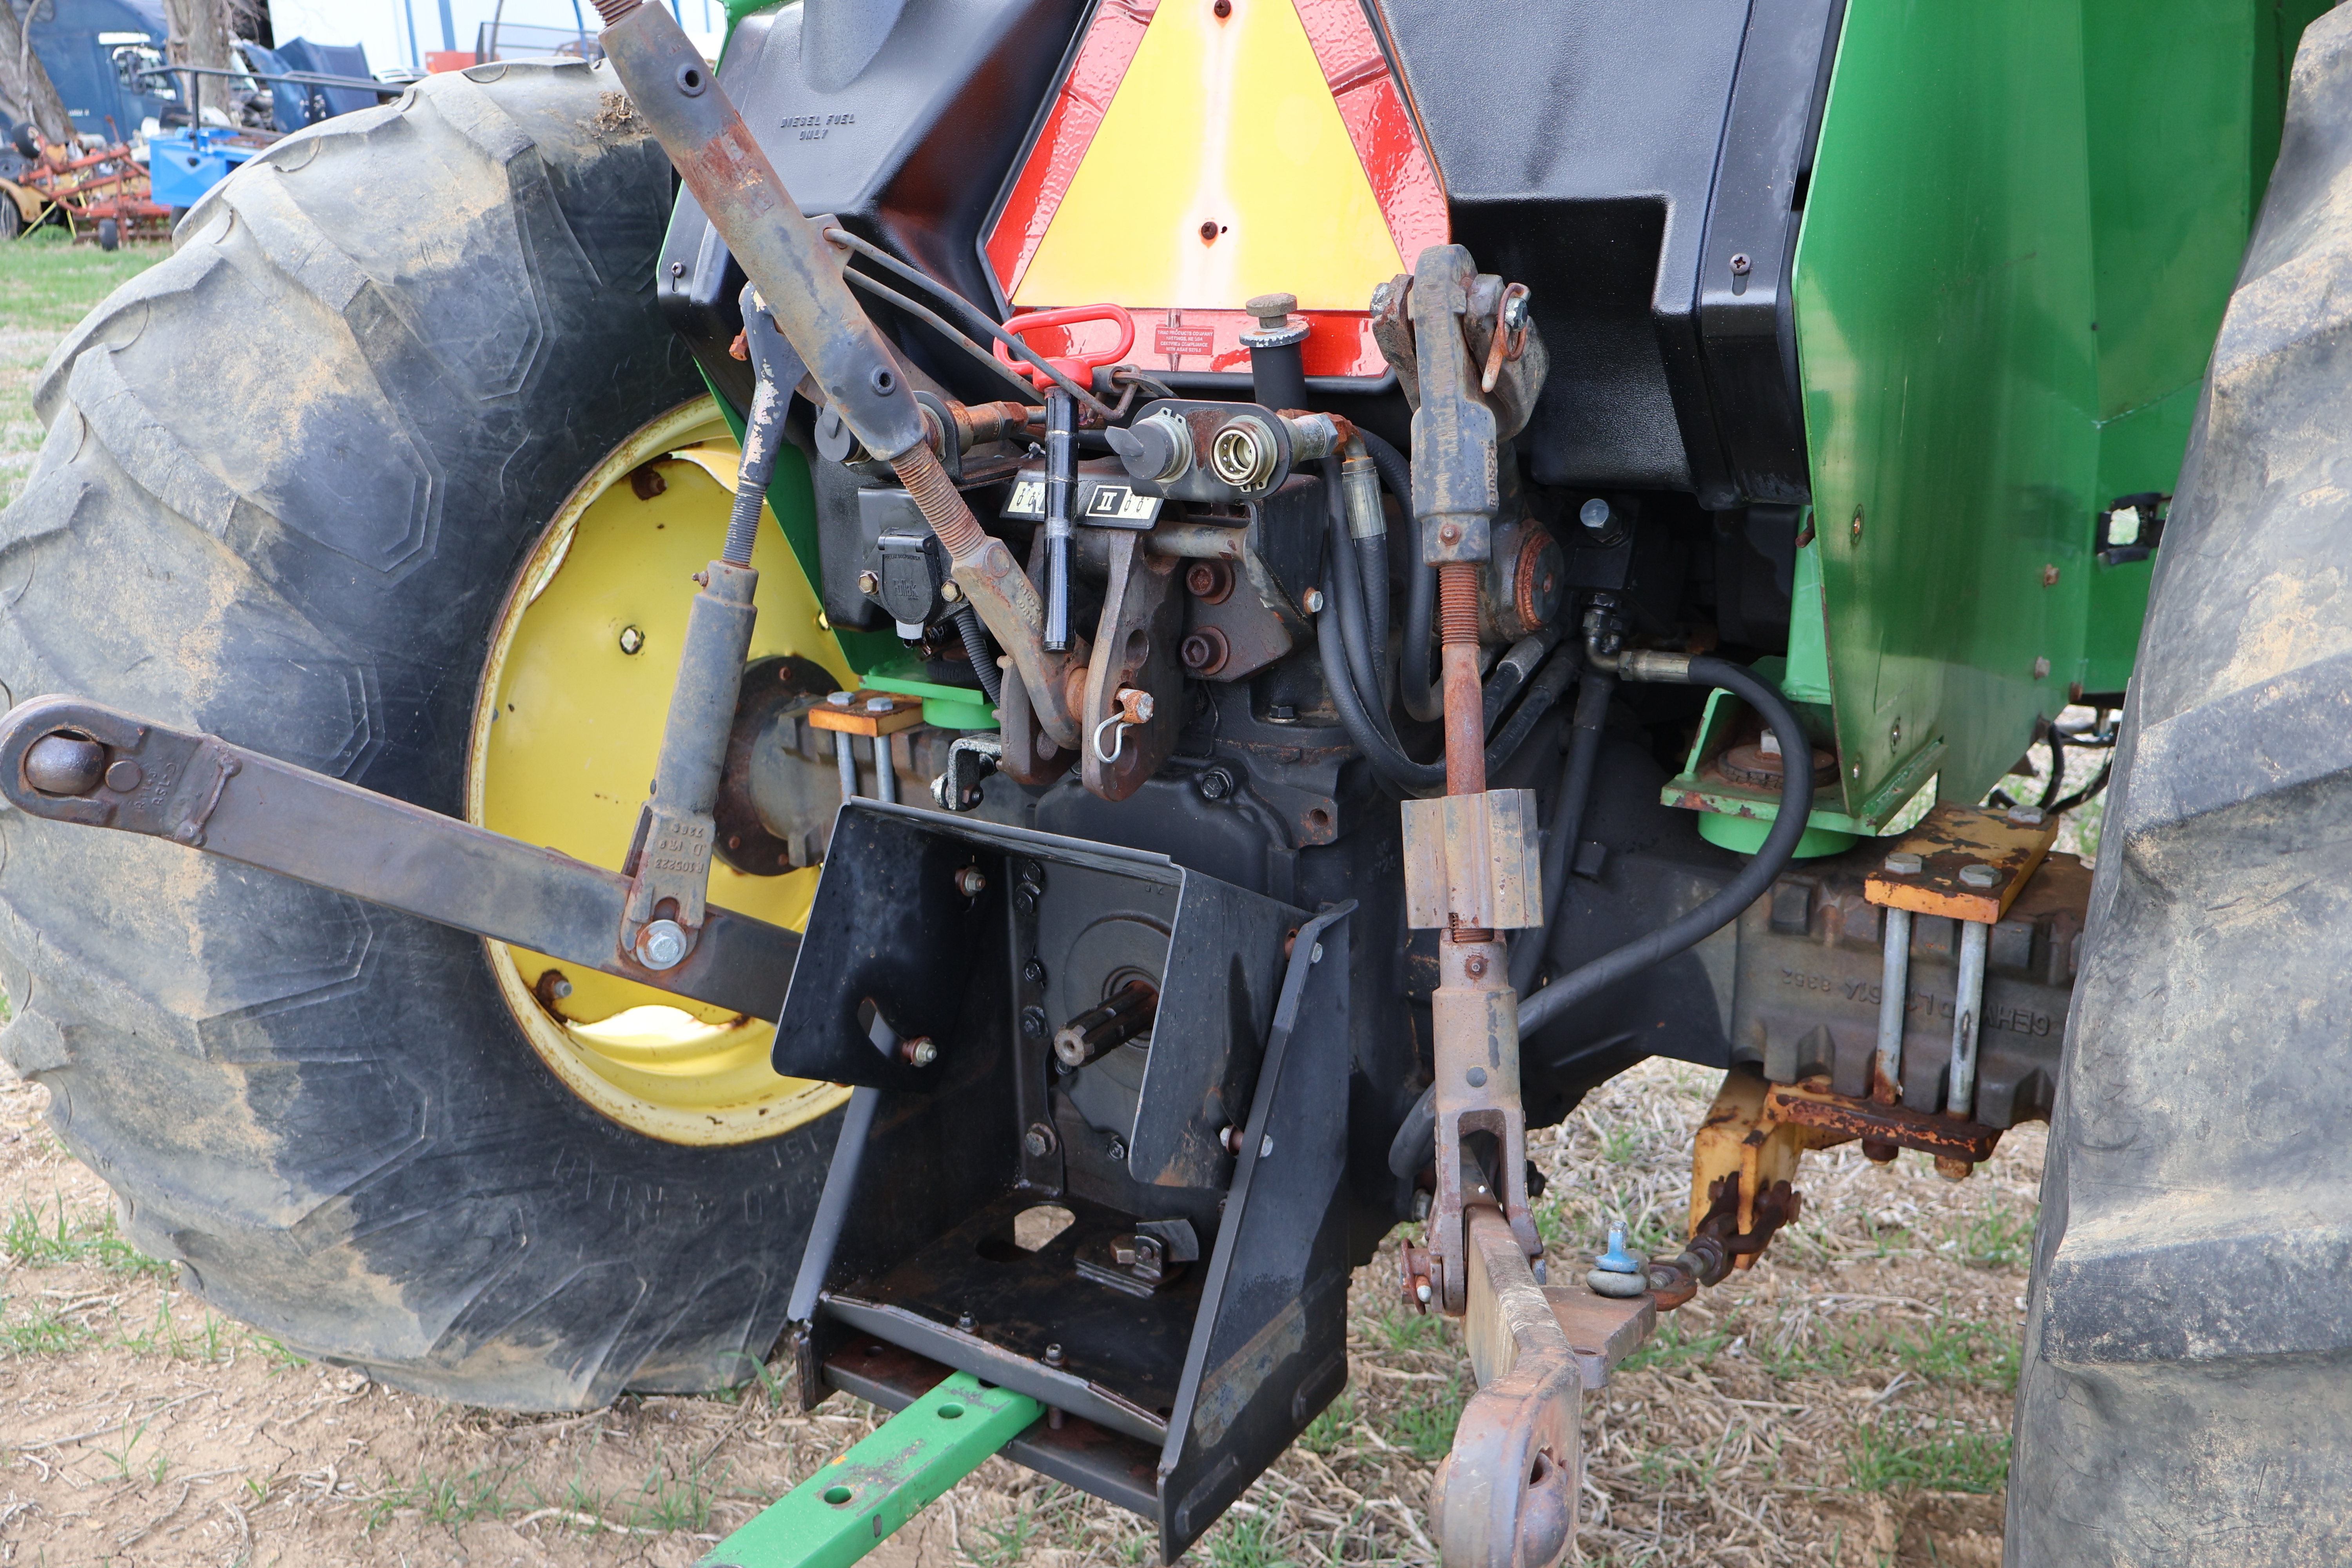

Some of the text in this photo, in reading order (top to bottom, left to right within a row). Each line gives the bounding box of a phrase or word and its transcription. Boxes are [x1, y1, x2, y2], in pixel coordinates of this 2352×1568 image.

[780, 113, 855, 128] DIESEL FUEL
[799, 129, 829, 140] ONLY
[892, 578, 919, 597] Pollak
